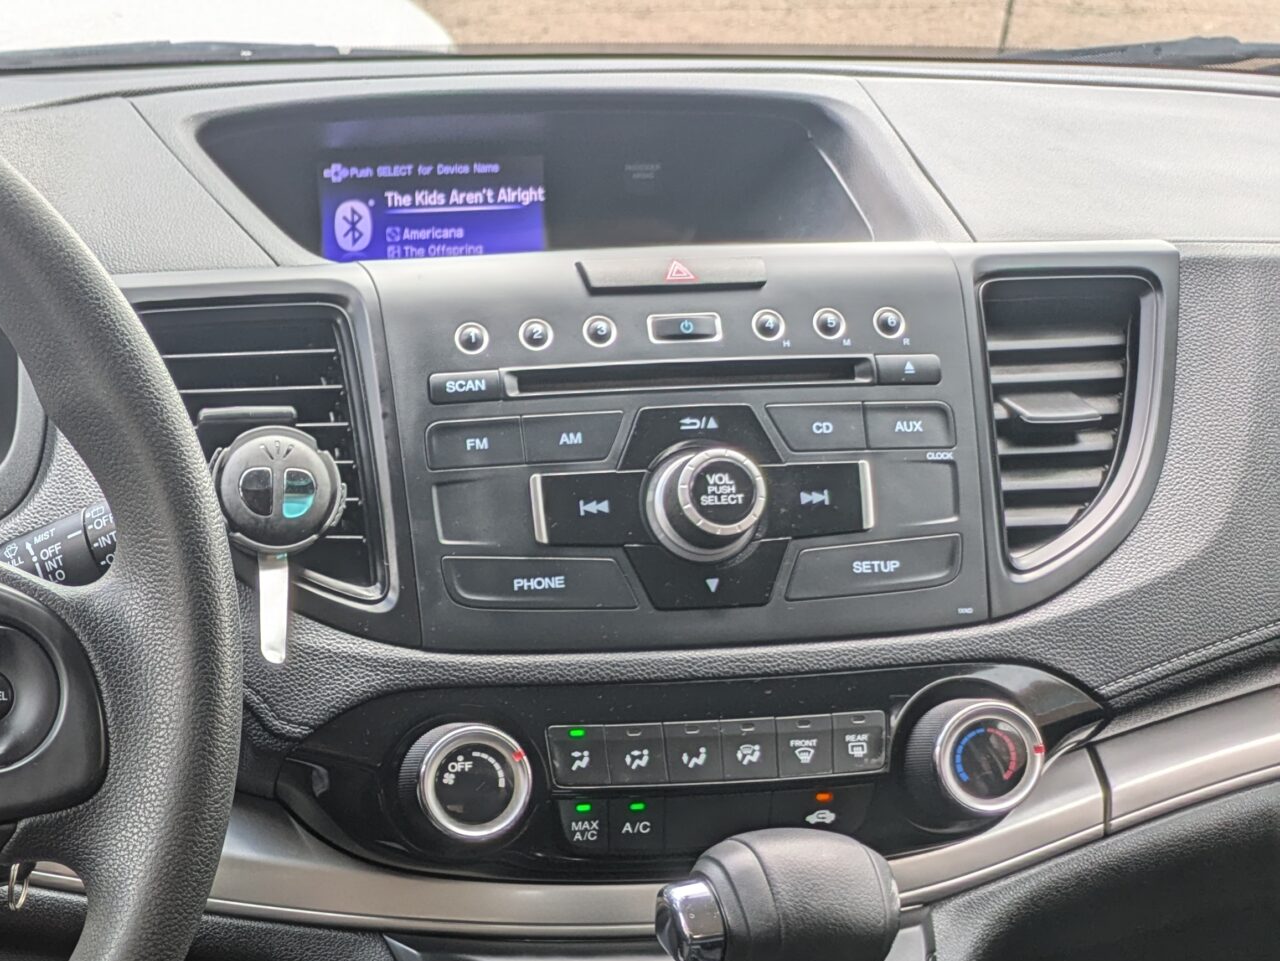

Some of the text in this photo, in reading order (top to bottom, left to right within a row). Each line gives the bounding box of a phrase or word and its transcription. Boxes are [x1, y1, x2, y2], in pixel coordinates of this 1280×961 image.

[350, 162, 500, 178] Push SELECT for Device Name
[385, 185, 546, 208] The Kids Aren't Alright
[403, 226, 465, 241] Americana
[403, 243, 484, 258] The Offspring
[765, 318, 775, 330] 4
[827, 317, 836, 328] 5
[887, 315, 897, 327] 6
[532, 327, 543, 339] 2
[597, 323, 607, 335] 3
[470, 332, 477, 344] 1
[783, 339, 791, 348] H
[843, 338, 852, 346] M
[903, 338, 910, 346] R
[446, 379, 486, 393] SCAN
[812, 422, 833, 433] CD
[895, 420, 923, 432] AUX
[559, 431, 582, 445] AM
[466, 438, 489, 451] FM
[926, 452, 954, 460] CLOCK
[706, 472, 735, 485] VOL
[708, 484, 736, 494] PUSH
[700, 493, 744, 506] SELECT
[93, 513, 113, 530] OFF
[33, 528, 56, 545] MIST
[97, 530, 117, 548] INT
[39, 542, 62, 560] OFF
[6, 556, 25, 568] ULL
[44, 554, 63, 572] INT
[852, 560, 901, 576] SETUP
[48, 569, 66, 583] LO
[513, 576, 566, 592] PHONE
[790, 738, 818, 747] FRONT
[845, 733, 870, 742] REAR
[448, 761, 473, 772] OFF
[571, 820, 599, 831] MAX
[621, 821, 651, 834] A/C
[573, 830, 598, 841] A/C
